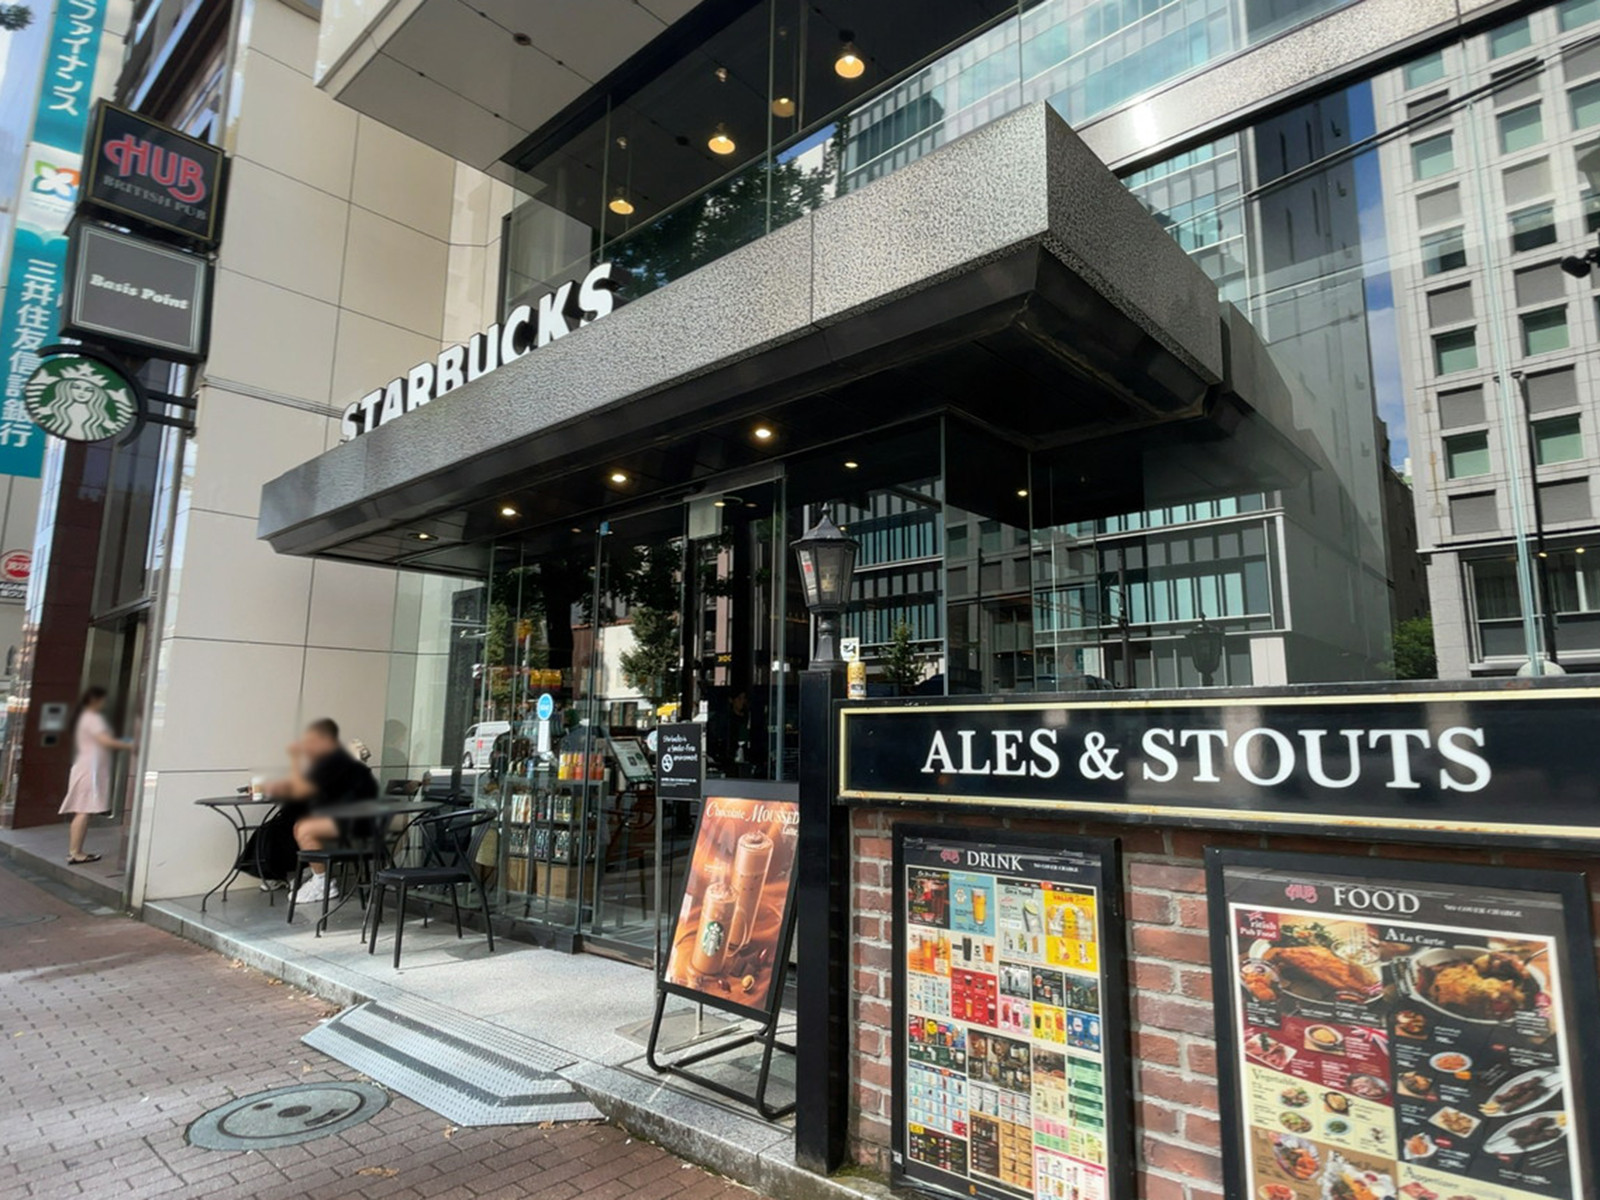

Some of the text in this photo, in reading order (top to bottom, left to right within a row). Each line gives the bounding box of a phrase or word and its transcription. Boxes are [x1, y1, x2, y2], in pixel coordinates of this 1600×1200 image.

[48, 0, 97, 116] ファイナンス
[104, 133, 206, 203] HUB
[103, 175, 172, 207] BRITISH
[169, 201, 207, 220] PUB
[89, 273, 189, 310] Basis Point
[340, 262, 613, 441] STARBUCKS
[920, 726, 1493, 793] ALES & STOUTS
[966, 850, 1024, 872] DRINK
[1333, 886, 1420, 914] FOOD
[1384, 927, 1446, 946] A La Carte
